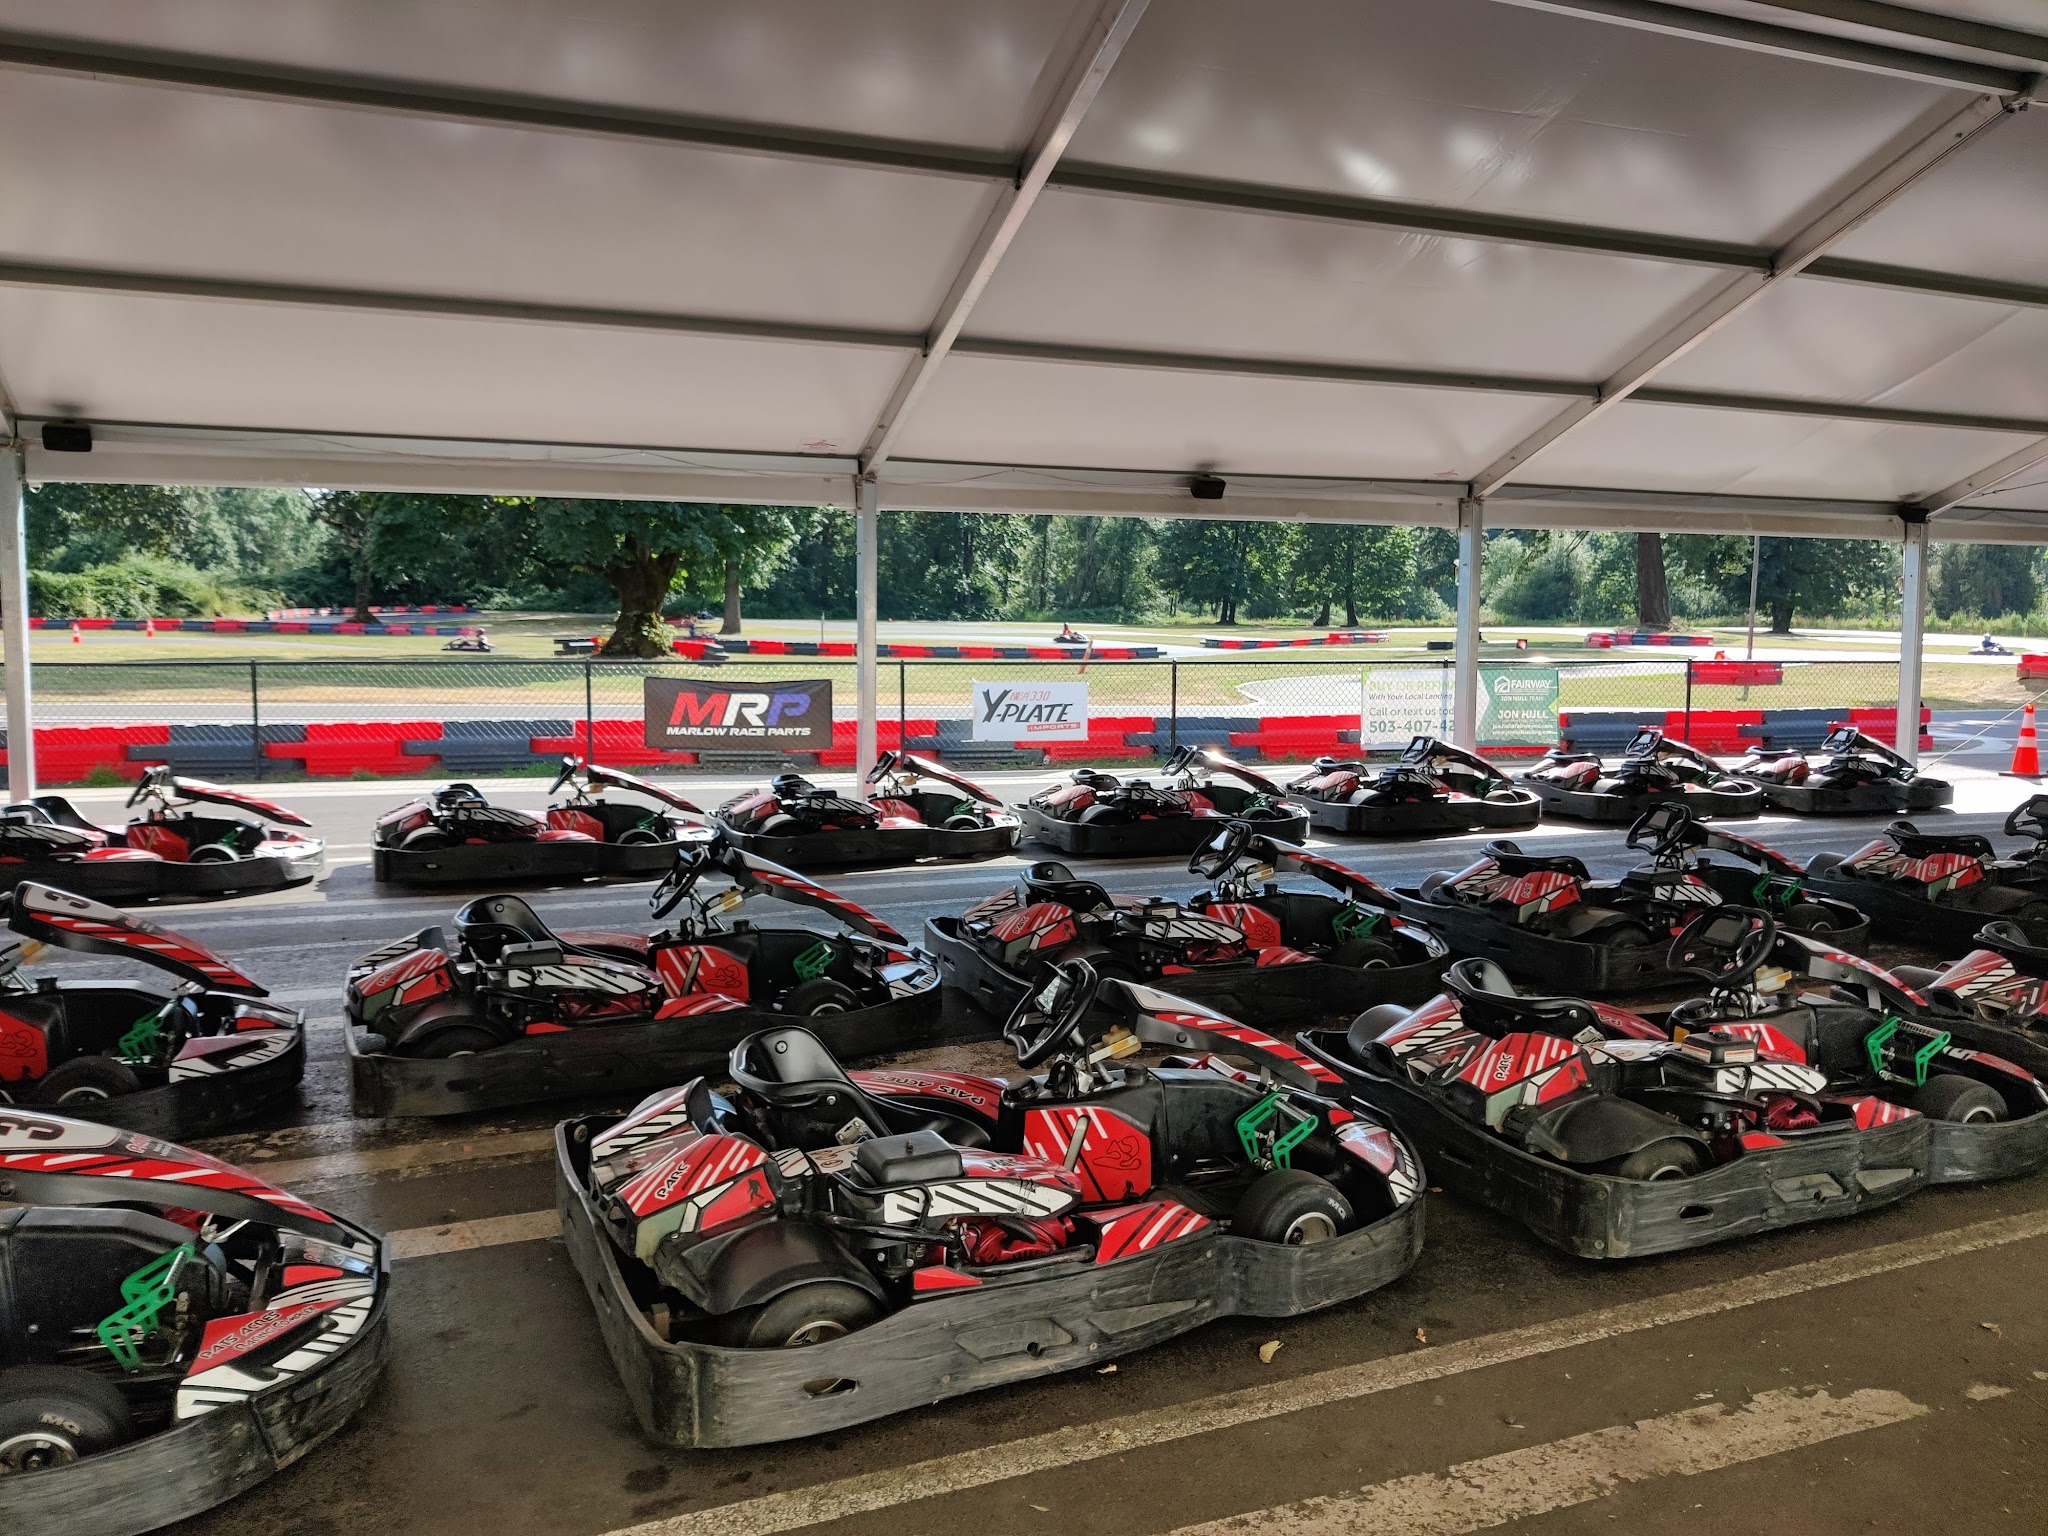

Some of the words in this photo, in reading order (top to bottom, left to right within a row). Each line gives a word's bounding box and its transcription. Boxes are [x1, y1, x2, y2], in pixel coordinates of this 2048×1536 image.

[1511, 679, 1551, 689] FAIRWAY
[1425, 693, 1453, 701] Lending
[669, 692, 811, 726] MRP
[1369, 708, 1388, 716] Call
[1404, 708, 1423, 716] text
[1497, 710, 1519, 719] JON
[1521, 710, 1548, 719] HULL
[666, 727, 727, 736] MARLOW
[729, 727, 765, 736] RACE
[767, 727, 811, 736] PARTS
[932, 1083, 985, 1106] PATS
[654, 1160, 691, 1200] PARC
[198, 1333, 240, 1359] PATS
